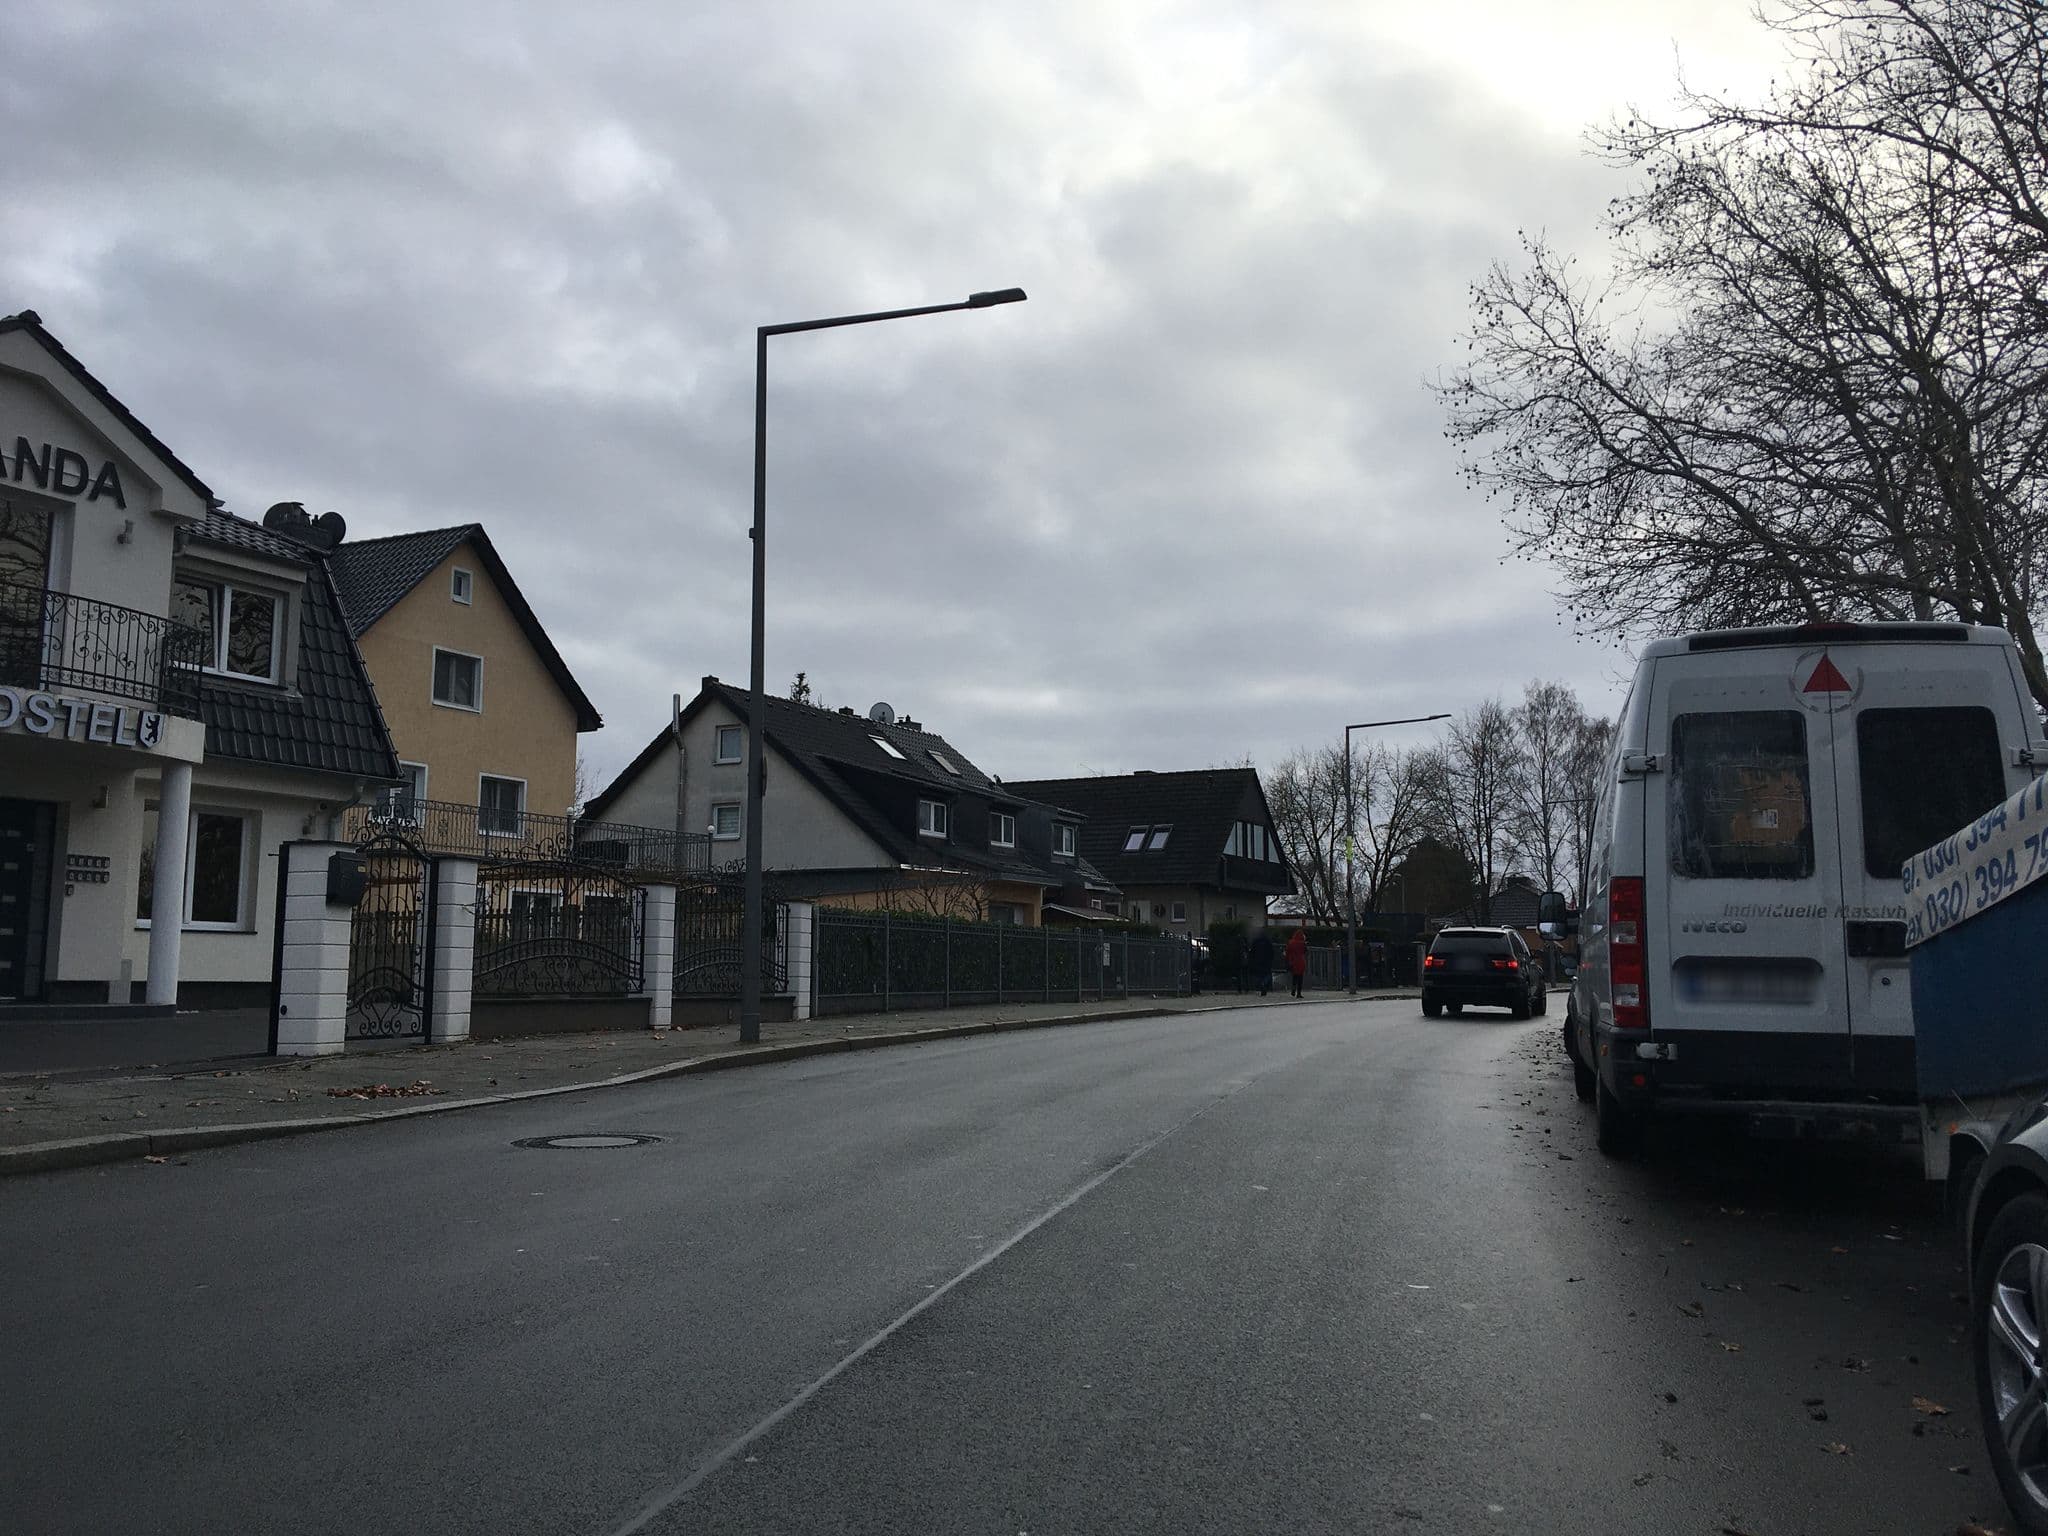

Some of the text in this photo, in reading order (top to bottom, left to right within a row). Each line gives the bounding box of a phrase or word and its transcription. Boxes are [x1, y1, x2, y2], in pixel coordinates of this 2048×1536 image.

[0, 436, 127, 510] NDA
[1723, 903, 1908, 920] Individuelle Massivh
[1906, 909, 1925, 946] ax
[1975, 847, 2019, 909] 394
[1681, 920, 1748, 934] IVECO
